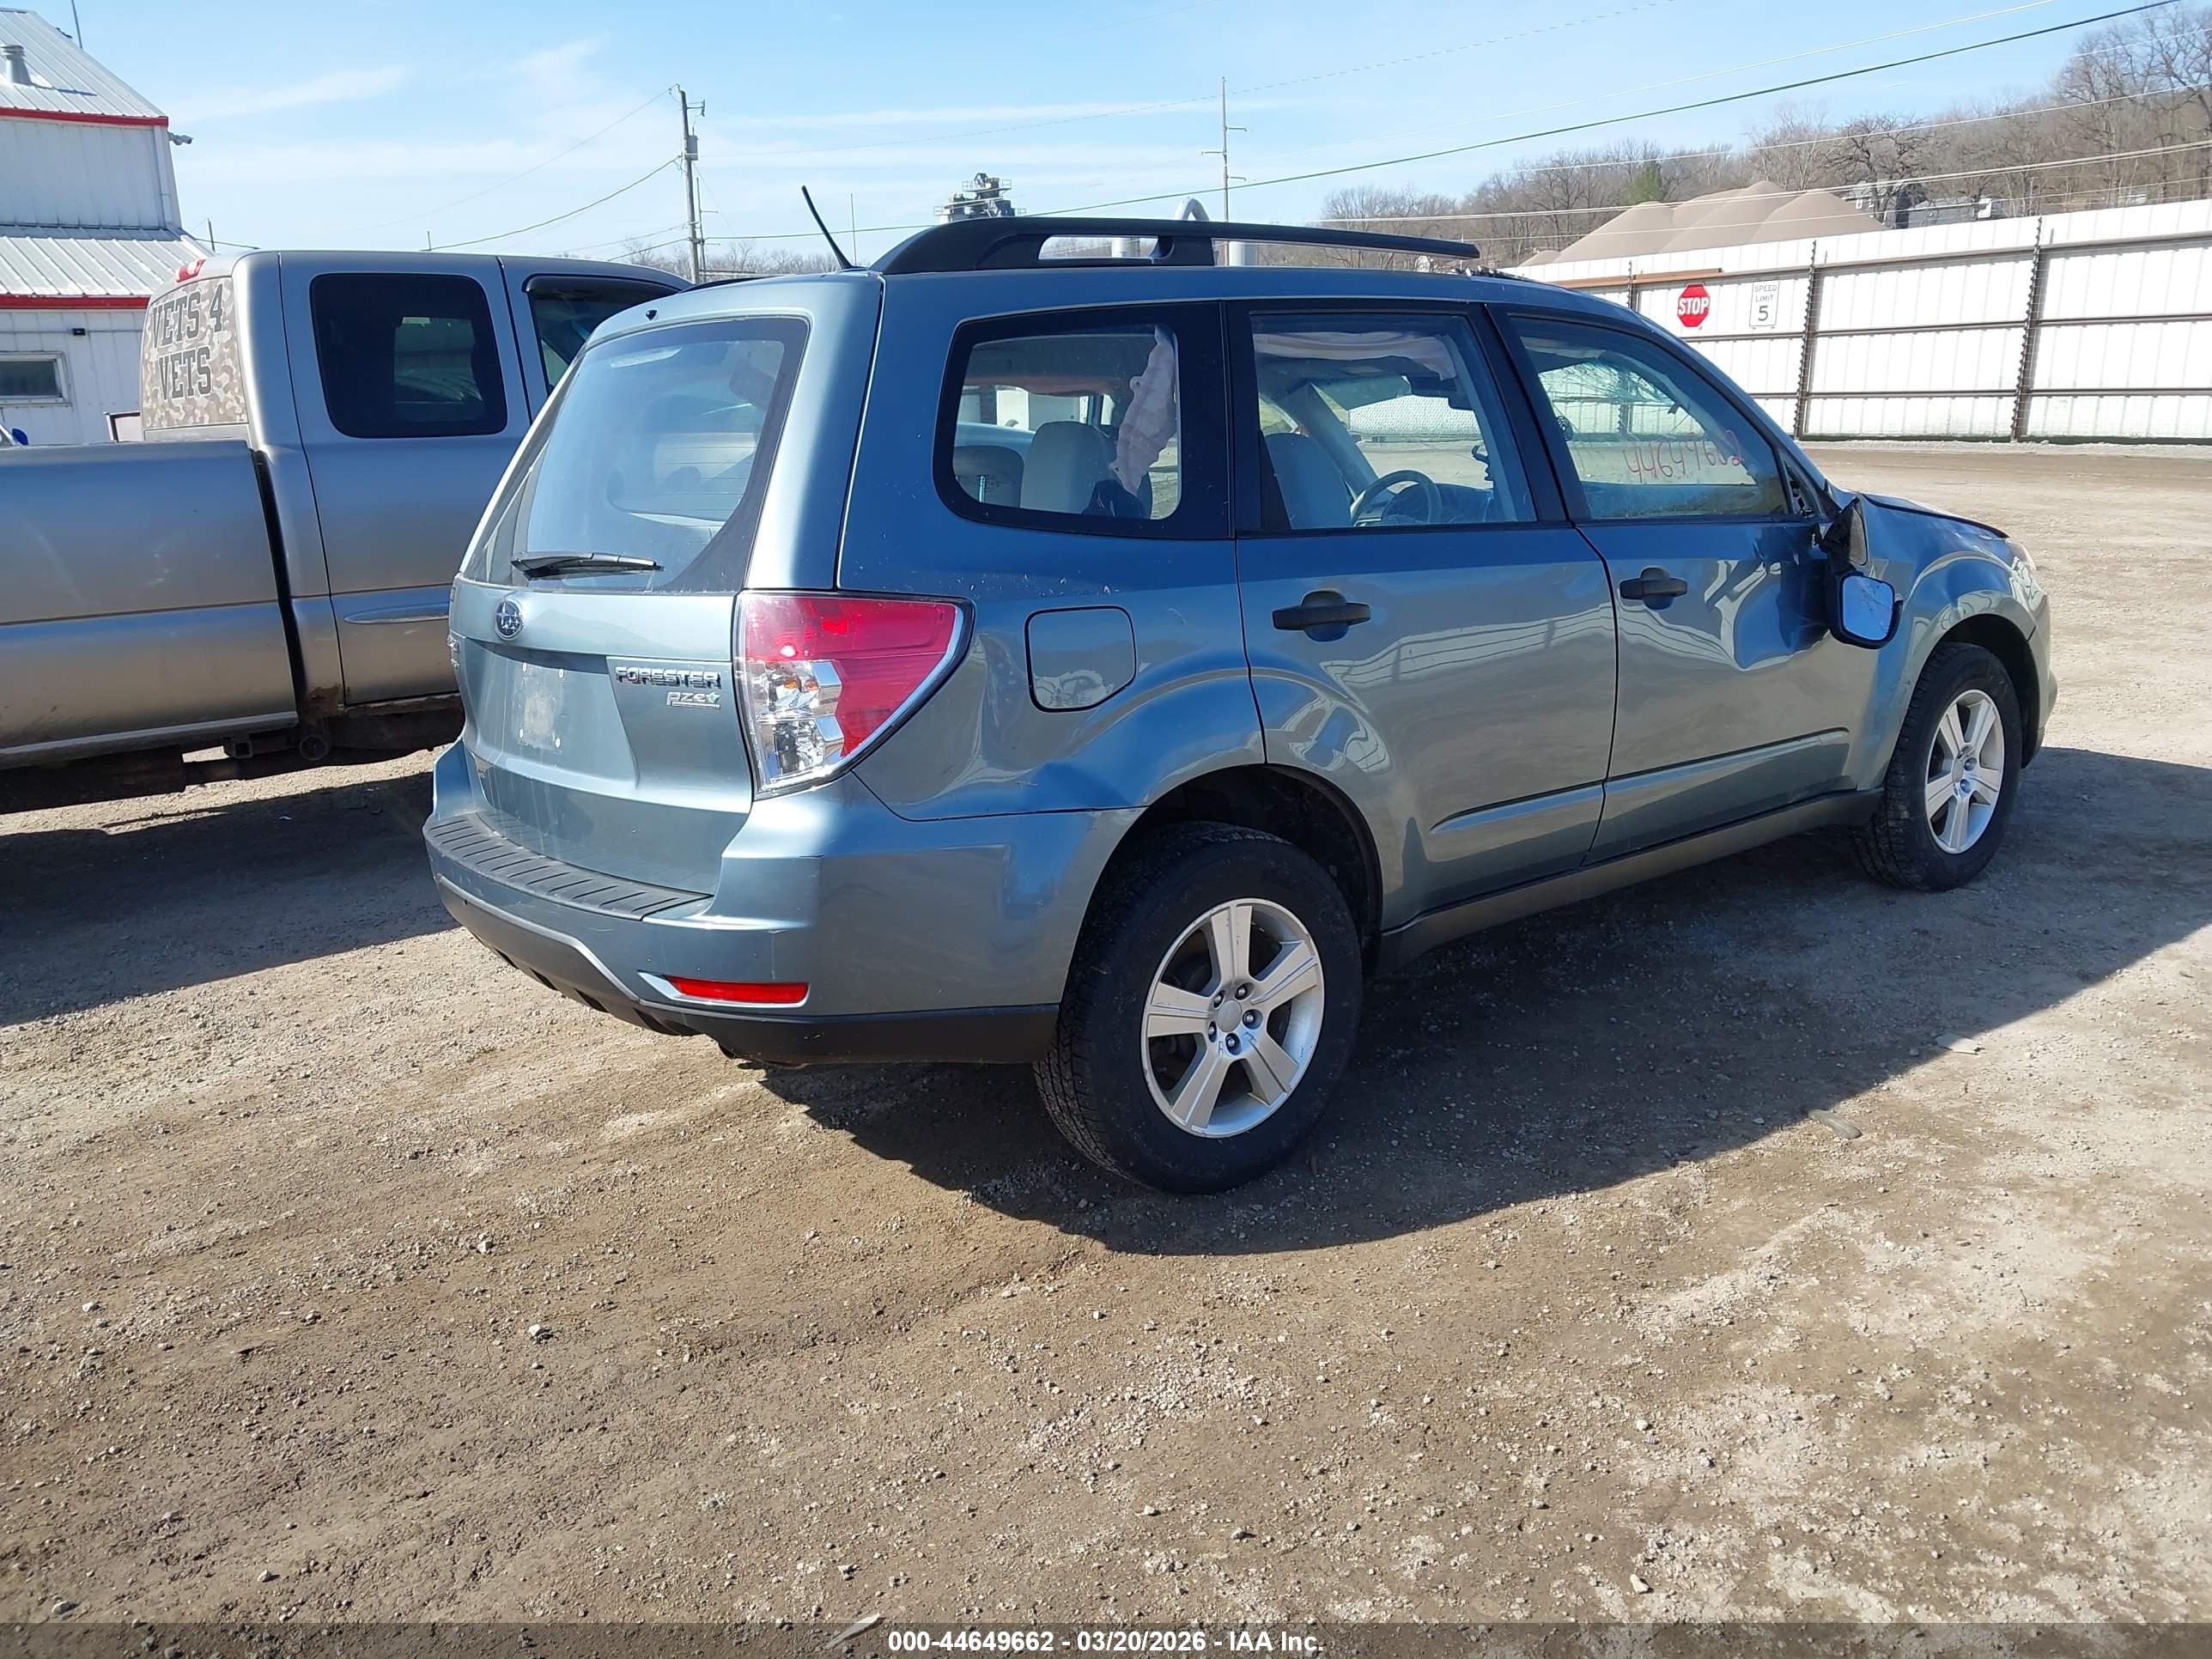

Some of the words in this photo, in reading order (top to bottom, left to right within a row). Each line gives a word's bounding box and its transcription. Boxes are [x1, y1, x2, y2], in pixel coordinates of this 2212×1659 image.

[152, 290, 201, 349] VETS
[210, 283, 223, 332] 4
[1679, 297, 1709, 316] STOP
[1758, 305, 1769, 321] 5
[159, 346, 211, 400] VETS
[615, 666, 721, 689] FORESTER
